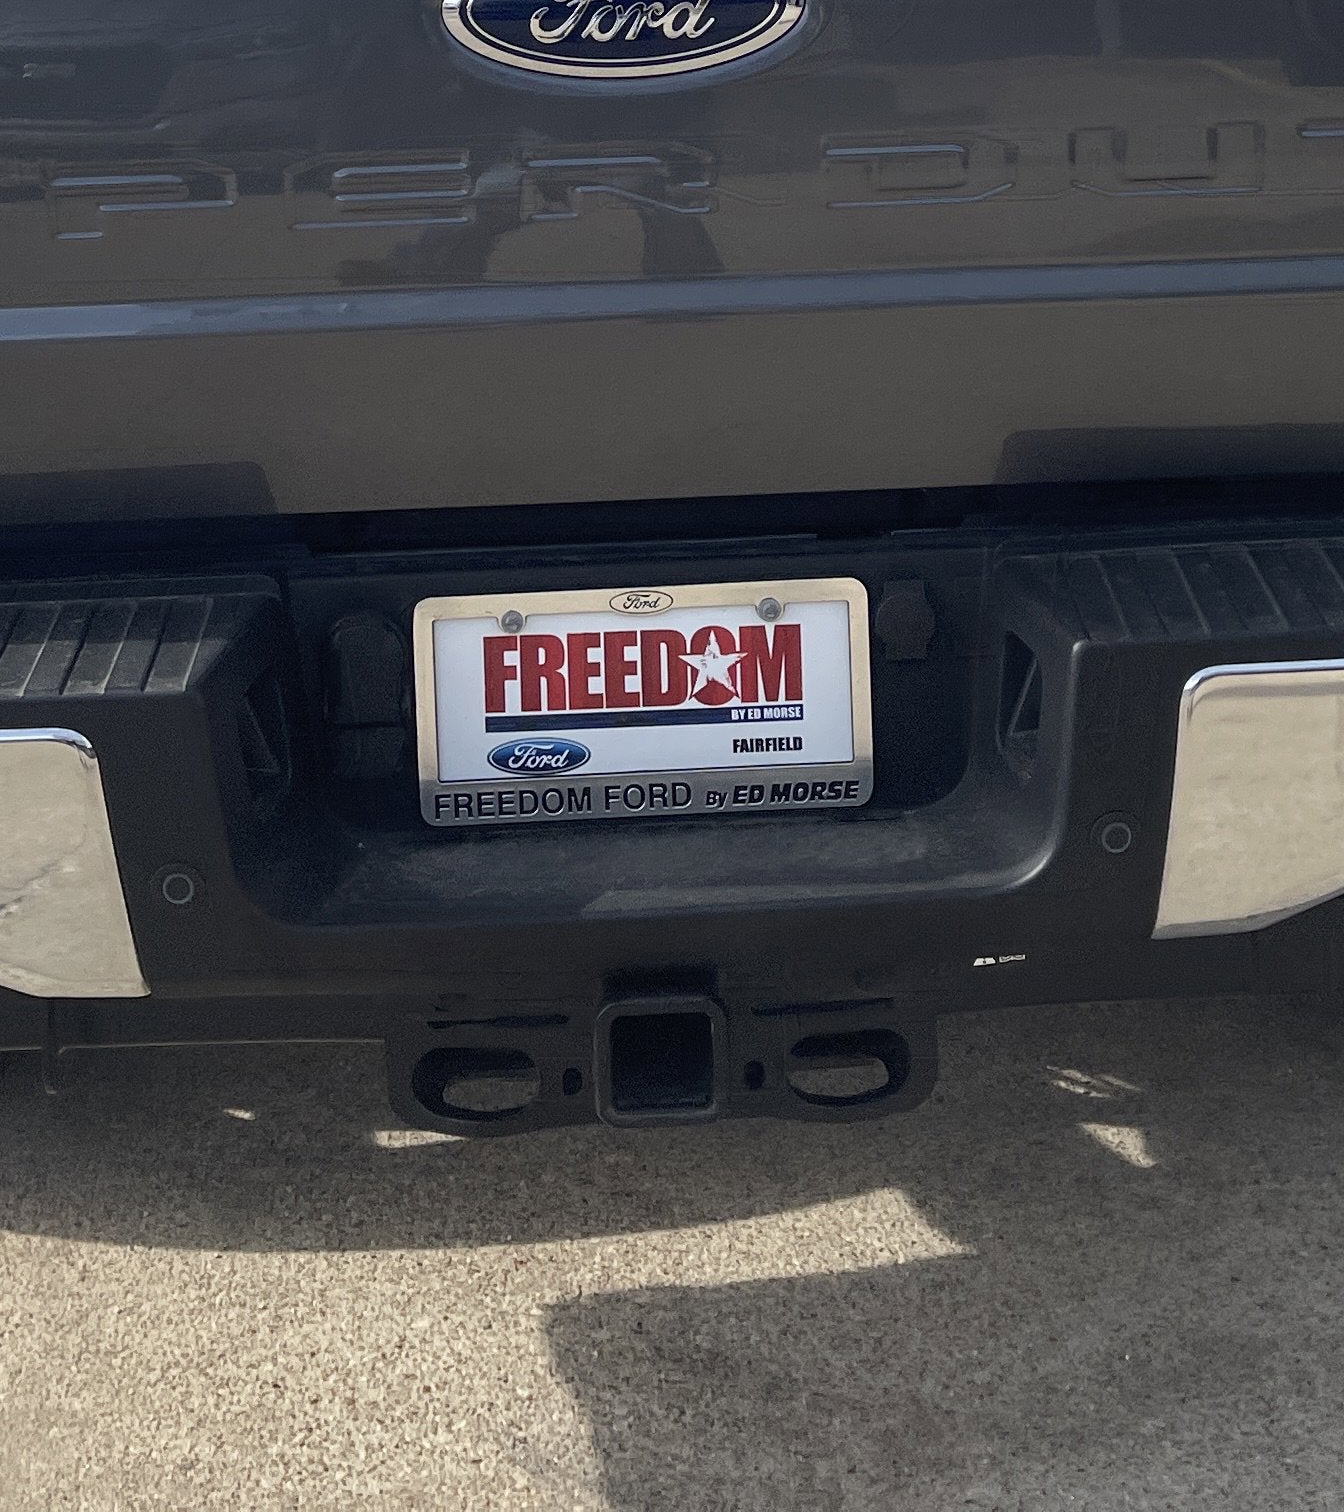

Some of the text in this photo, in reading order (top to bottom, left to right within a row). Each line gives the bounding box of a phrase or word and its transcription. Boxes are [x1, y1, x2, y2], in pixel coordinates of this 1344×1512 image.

[623, 592, 661, 611] Ford
[482, 623, 804, 713] FREEDOM
[731, 706, 802, 721] BY ED MORSE
[508, 740, 570, 770] Ford
[732, 736, 803, 754] FAIRFIELD
[434, 787, 592, 821] FREEDOM
[604, 782, 693, 813] FORD
[732, 783, 766, 806] ED
[769, 779, 861, 804] MORSE
